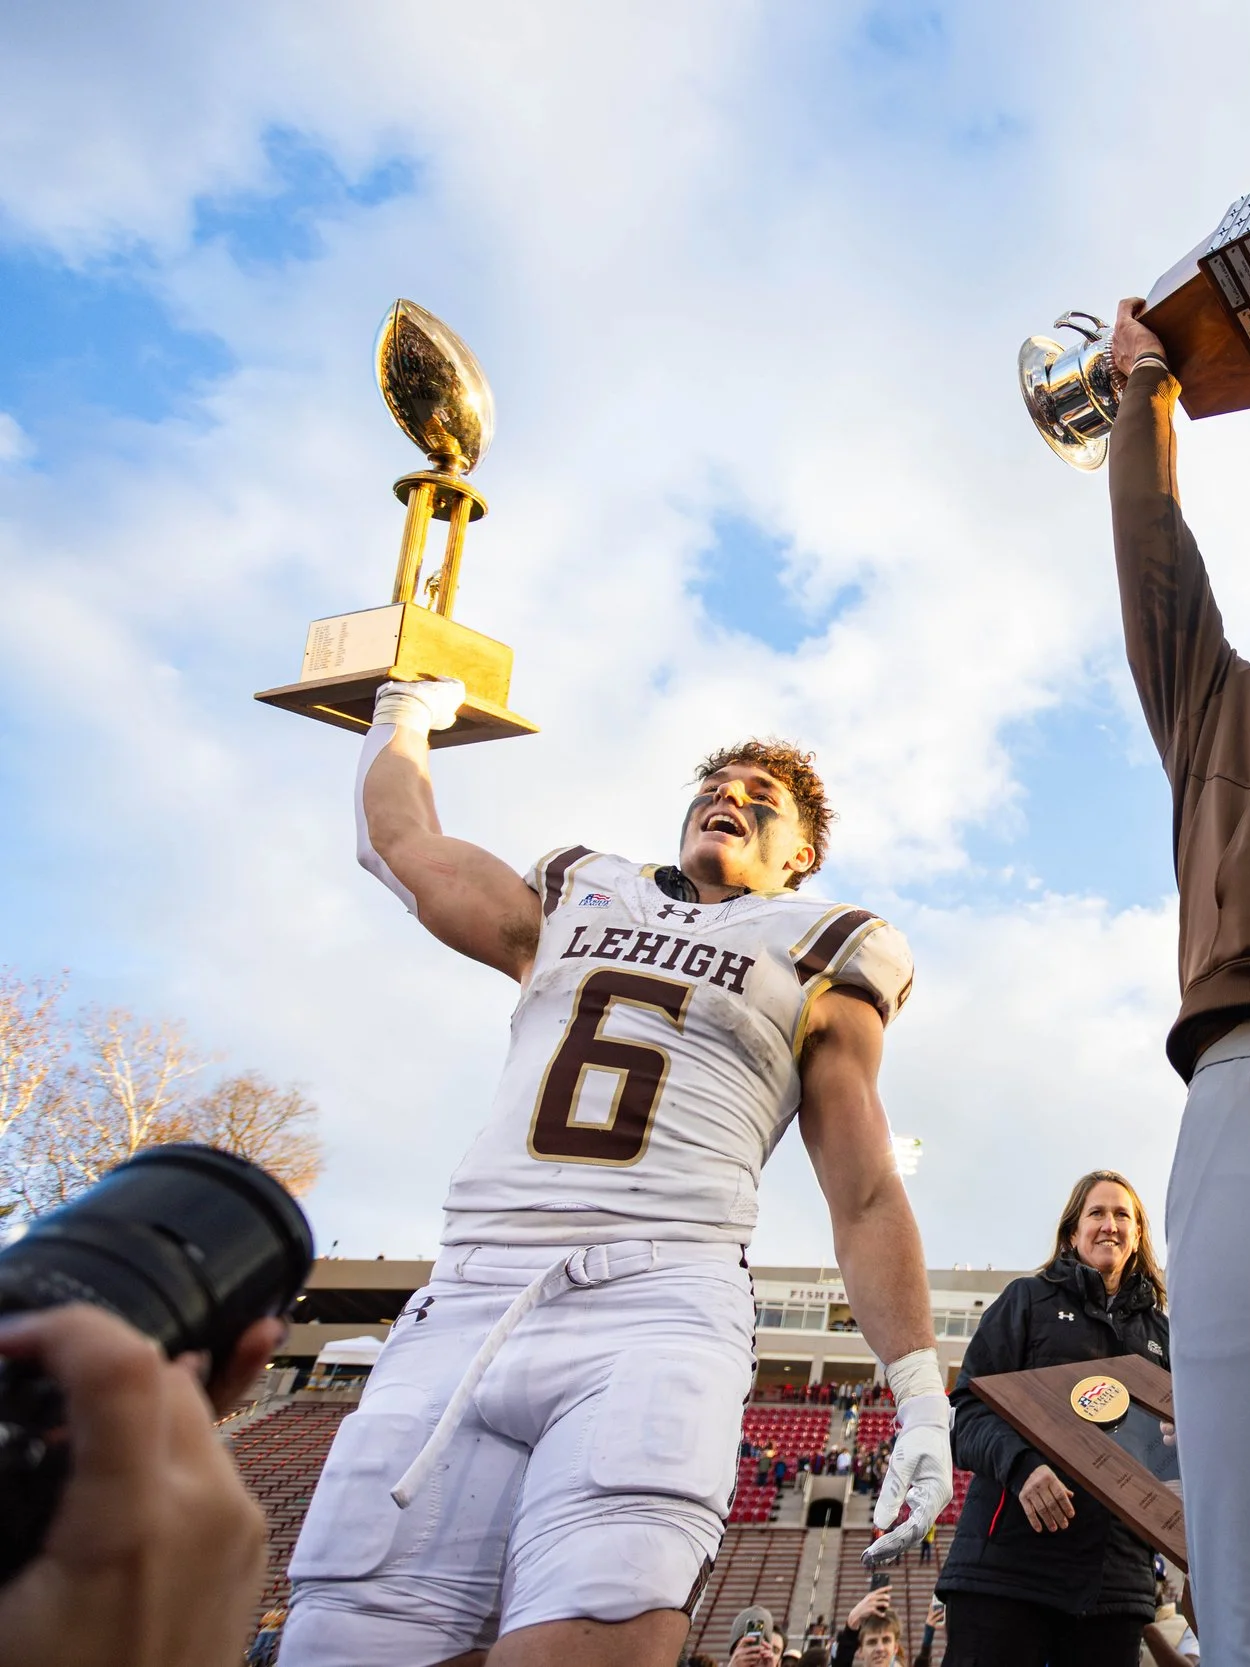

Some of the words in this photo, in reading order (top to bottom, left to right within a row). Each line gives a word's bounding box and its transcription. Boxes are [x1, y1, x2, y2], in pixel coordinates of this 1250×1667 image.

[561, 925, 755, 995] LEHIGH
[527, 966, 697, 1167] 6
[790, 1290, 845, 1300] FISHER
[1083, 1384, 1116, 1414] PATRIOT
